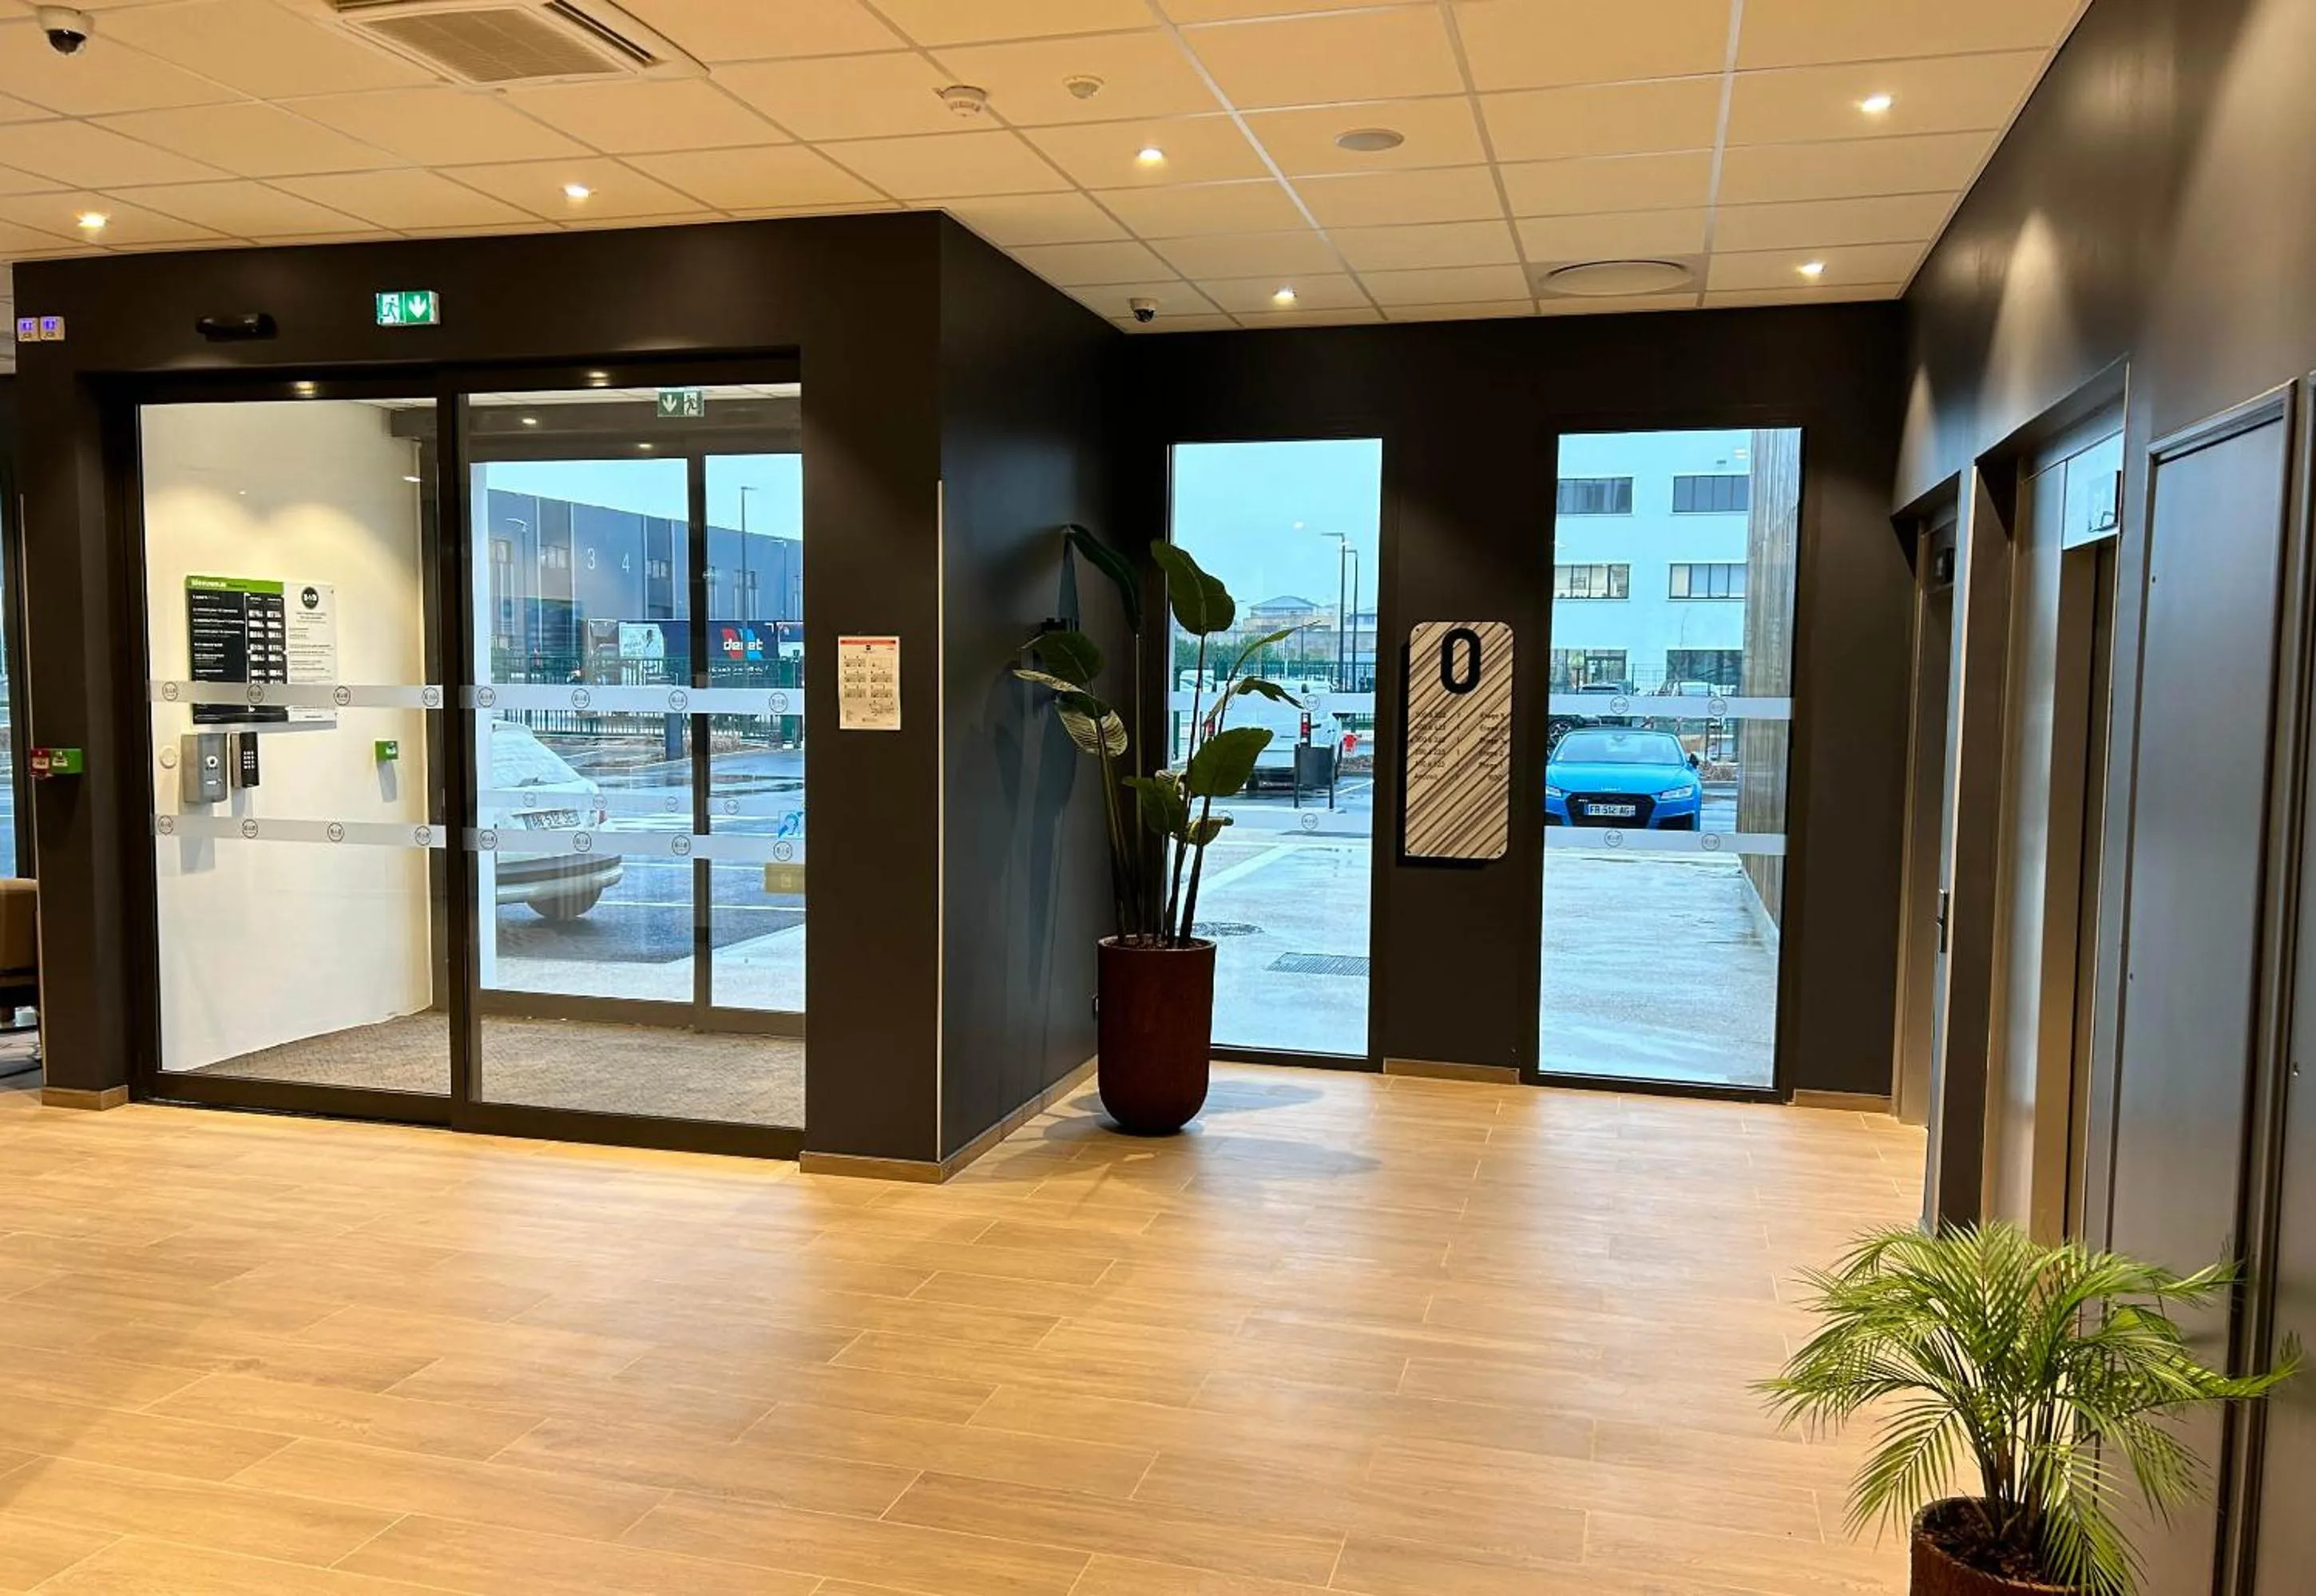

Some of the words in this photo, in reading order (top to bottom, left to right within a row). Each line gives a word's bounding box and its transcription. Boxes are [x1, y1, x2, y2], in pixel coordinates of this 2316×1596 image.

[588, 548, 595, 569] 3
[622, 552, 630, 573] 4
[1441, 628, 1481, 694] 0
